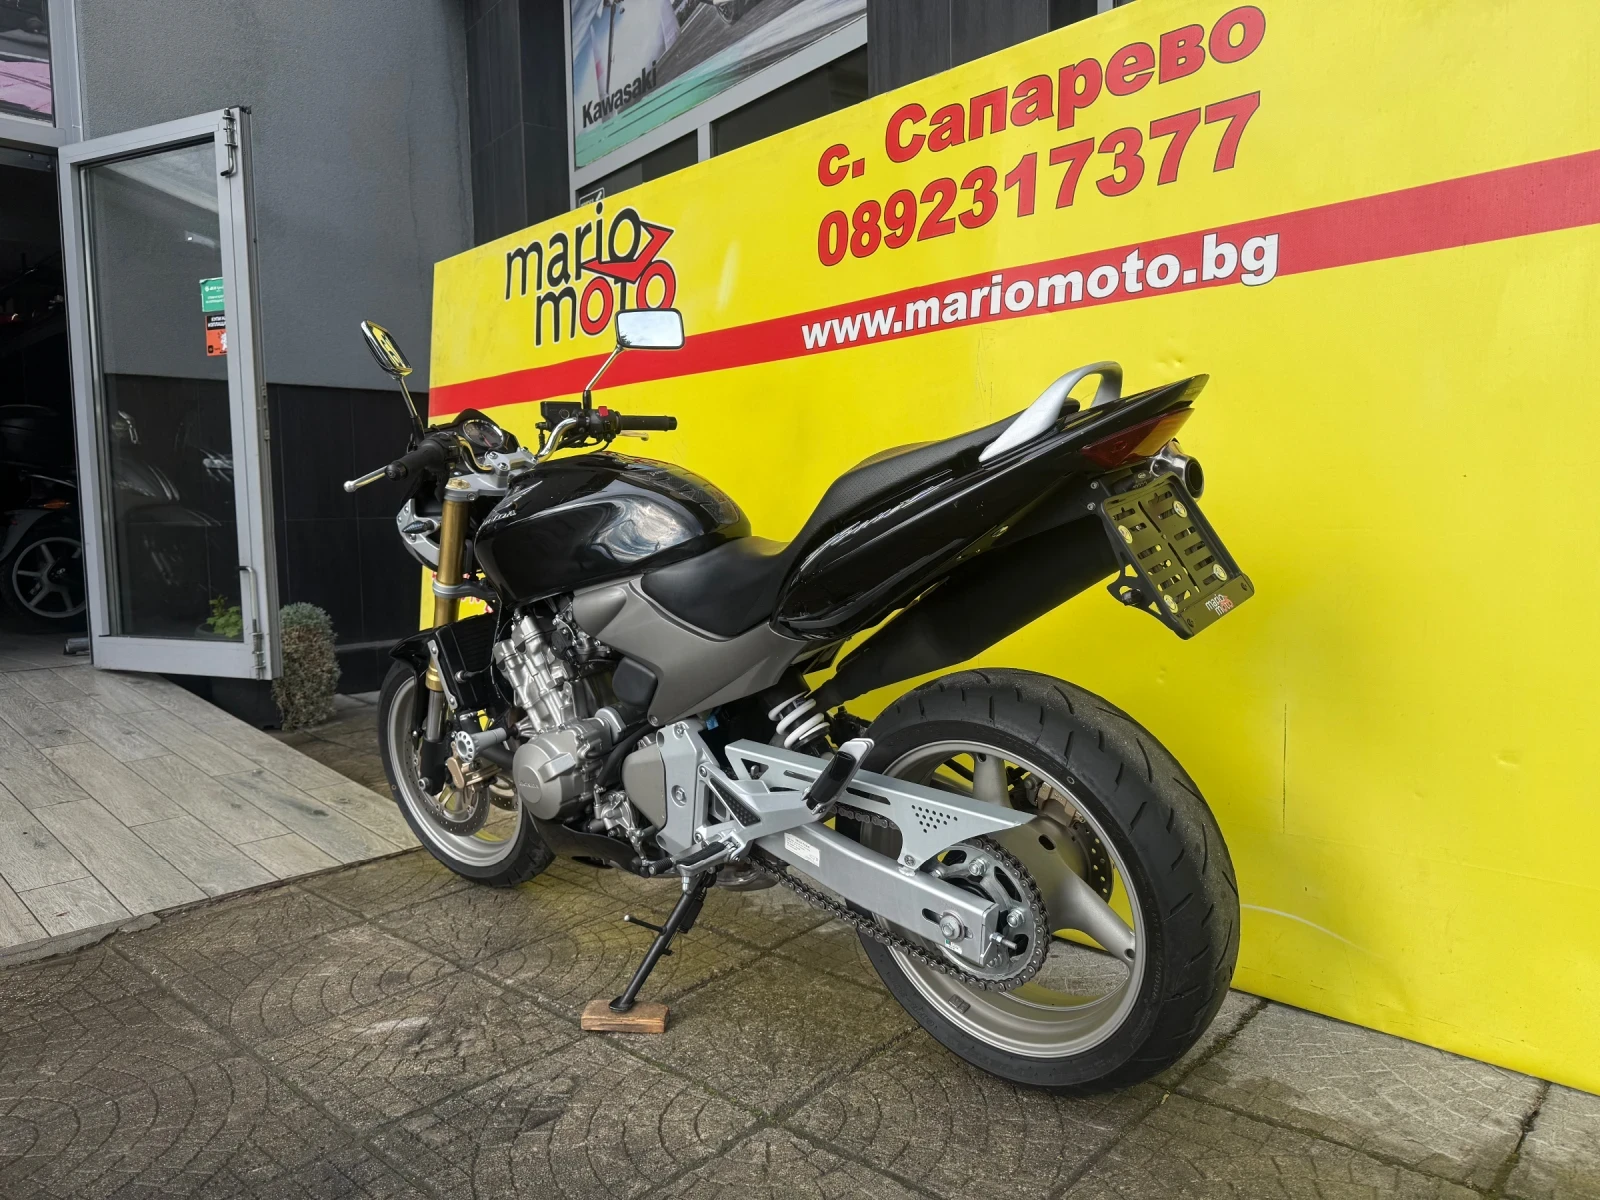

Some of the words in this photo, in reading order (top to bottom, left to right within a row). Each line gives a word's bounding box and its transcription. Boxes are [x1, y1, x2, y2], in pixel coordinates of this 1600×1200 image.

[582, 60, 657, 128] Kawasaki
[817, 143, 865, 187] с.
[885, 5, 1266, 163] Сапарево
[817, 91, 1261, 267] 0892317377
[505, 201, 641, 300] mario
[535, 260, 676, 346] moto
[801, 233, 1279, 350] www.mariomoto.bg
